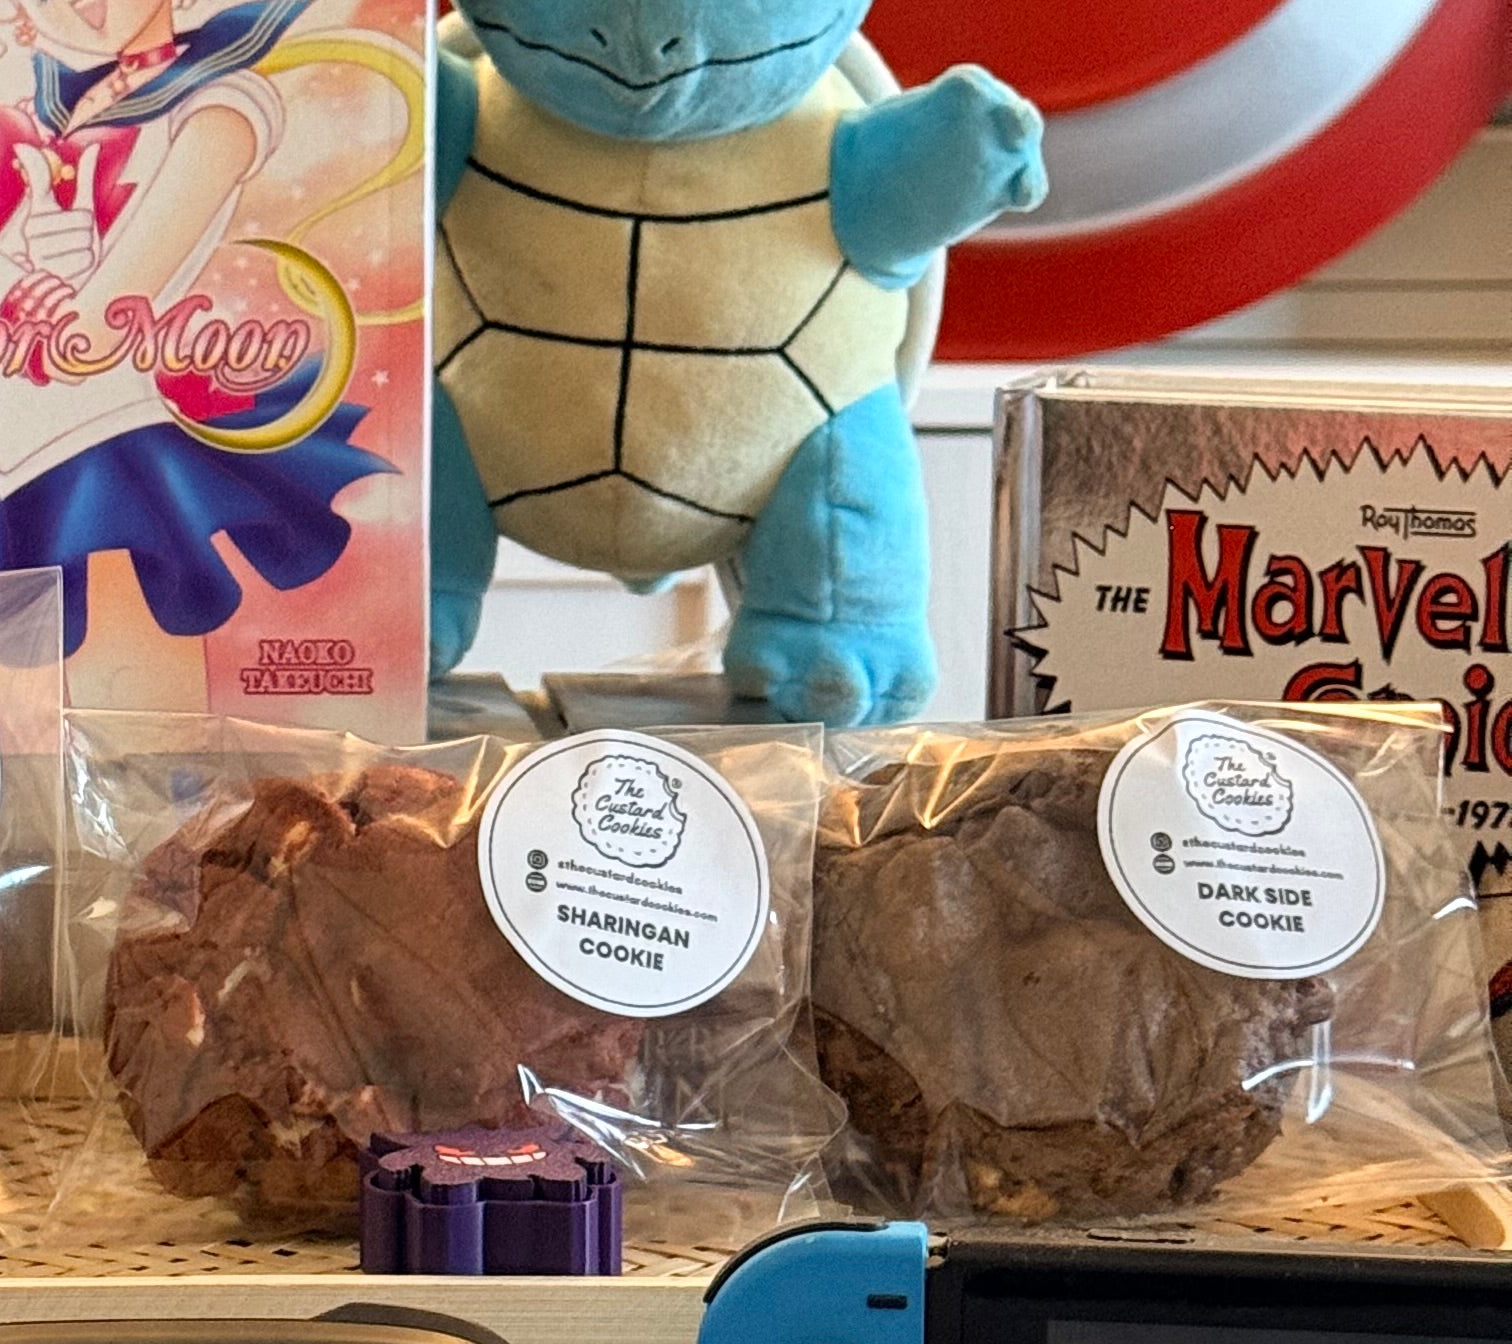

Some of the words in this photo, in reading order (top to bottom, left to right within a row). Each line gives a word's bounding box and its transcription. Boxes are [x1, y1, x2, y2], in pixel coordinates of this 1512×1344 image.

[51, 293, 310, 394] Moon
[1095, 584, 1152, 614] THE
[1159, 508, 1512, 666] Marvel
[258, 638, 355, 667] NAOKO
[240, 668, 374, 696] TAKEUCHI
[1214, 756, 1246, 772] The
[614, 777, 645, 799] The
[1204, 771, 1272, 788] Custard
[595, 795, 667, 820] Custard
[1212, 788, 1274, 806] Cookies
[598, 814, 663, 839] Cookies
[1197, 882, 1261, 904] DARK
[1264, 887, 1313, 907] SIDE
[557, 904, 690, 949] SHARINGAN
[1218, 910, 1305, 933] COOKIE
[579, 938, 664, 971] COOKIE
